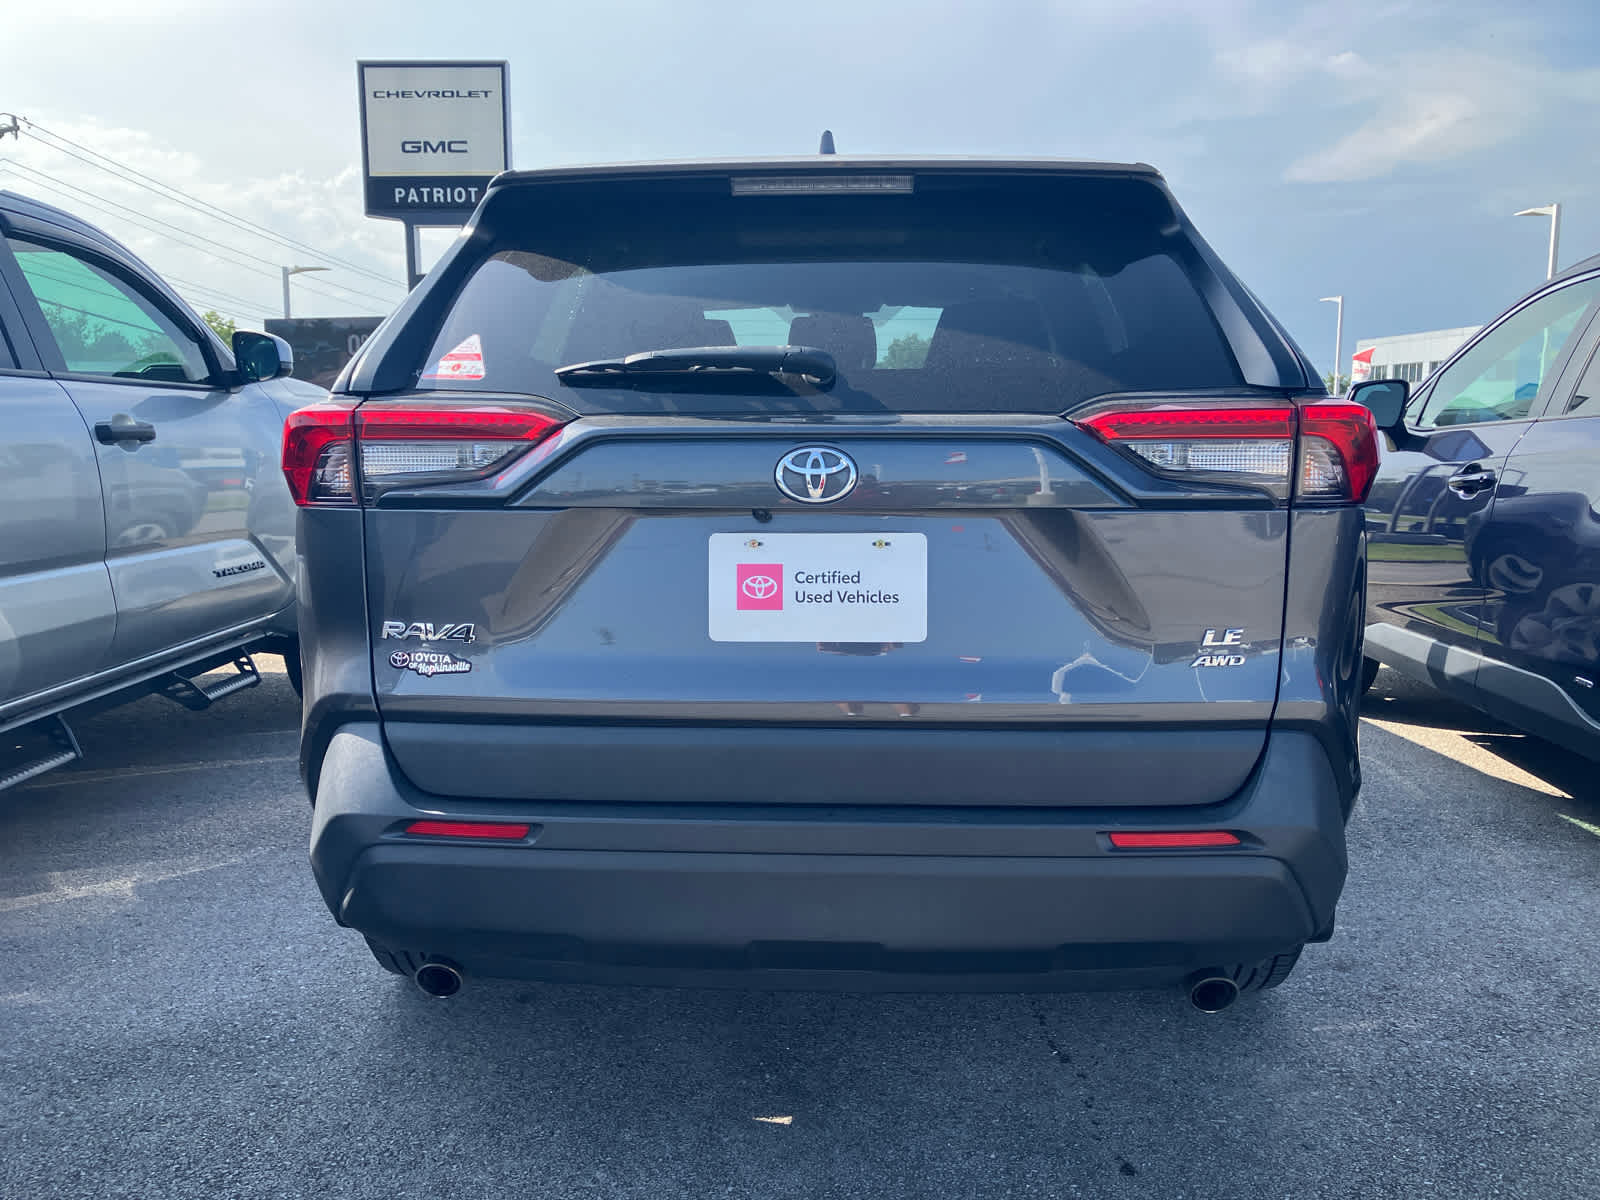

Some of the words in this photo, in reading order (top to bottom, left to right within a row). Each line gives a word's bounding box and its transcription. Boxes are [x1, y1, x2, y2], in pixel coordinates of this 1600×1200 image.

[373, 90, 492, 98] CHEVROLET
[401, 140, 468, 153] GMC
[394, 187, 478, 203] PATRIOT
[212, 561, 265, 577] TACOMA
[795, 571, 860, 584] Certified
[795, 590, 833, 604] Used
[837, 590, 899, 604] Vehicles
[382, 621, 475, 643] RAV4
[1202, 629, 1243, 646] LE
[410, 652, 451, 663] TOYOTA
[1191, 655, 1245, 667] AWD
[418, 662, 470, 676] Hopkinsville
